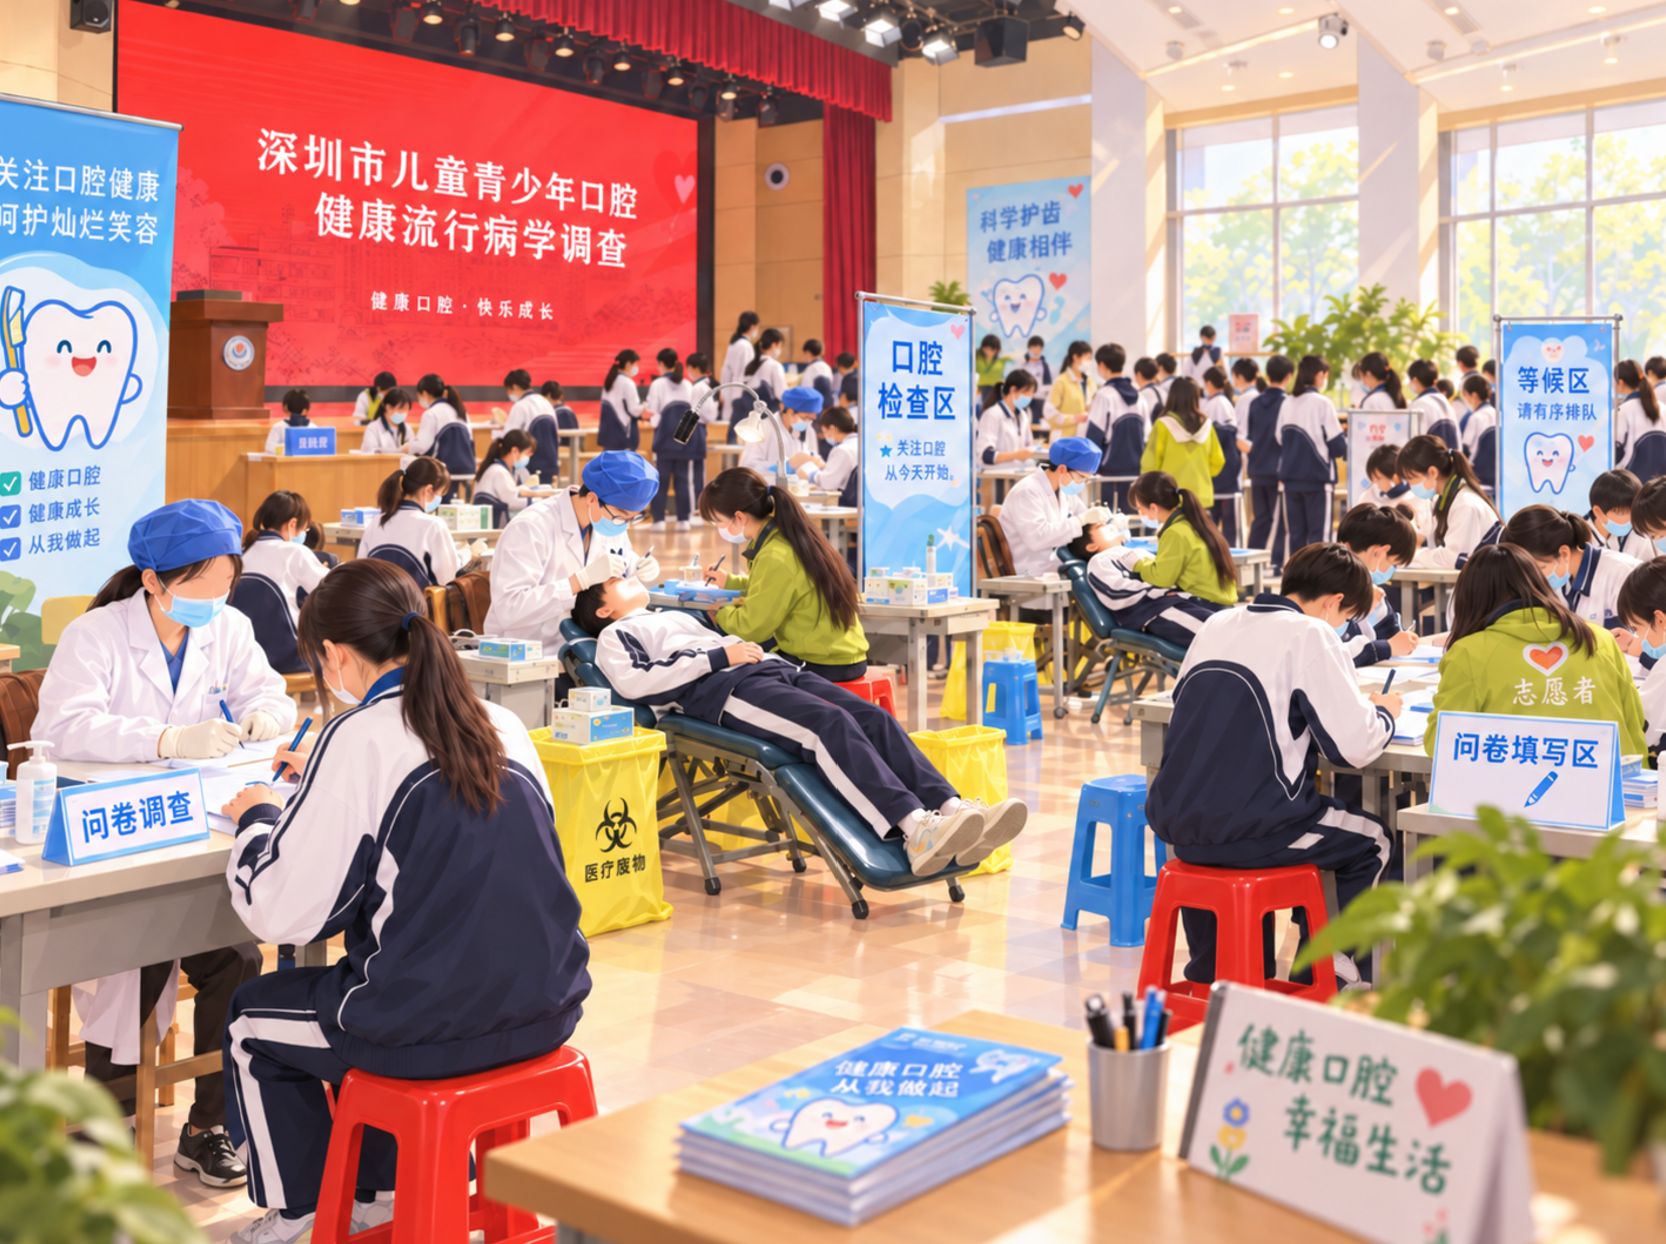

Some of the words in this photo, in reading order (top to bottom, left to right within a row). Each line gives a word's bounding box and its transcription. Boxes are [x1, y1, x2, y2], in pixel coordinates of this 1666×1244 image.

[0, 155, 160, 203] 关注口腔健康
[257, 127, 638, 220] 深圳市儿童青少年口腔
[0, 202, 158, 245] 呵护灿烂笑容
[314, 191, 628, 268] 健康流行病学调查
[980, 201, 1060, 233] 科学护齿
[987, 231, 1073, 263] 健康相伴
[892, 340, 943, 376] 口腔
[1517, 366, 1590, 394] 等候区
[878, 382, 956, 421] 检查区
[1517, 402, 1597, 421] 请有序排队
[897, 439, 946, 458] 关注口腔
[28, 465, 101, 491] 健康口腔
[28, 497, 101, 524] 健康成长
[28, 527, 101, 555] 从我做起
[1512, 675, 1596, 706] 志愿者
[1453, 731, 1599, 769] 问卷填写区
[81, 790, 194, 843] 问卷调查
[835, 1059, 963, 1080] 健康口腔
[1237, 1023, 1398, 1107] 健康口腔
[830, 1079, 960, 1098] 从我做起
[1283, 1094, 1452, 1196] 幸福生活
